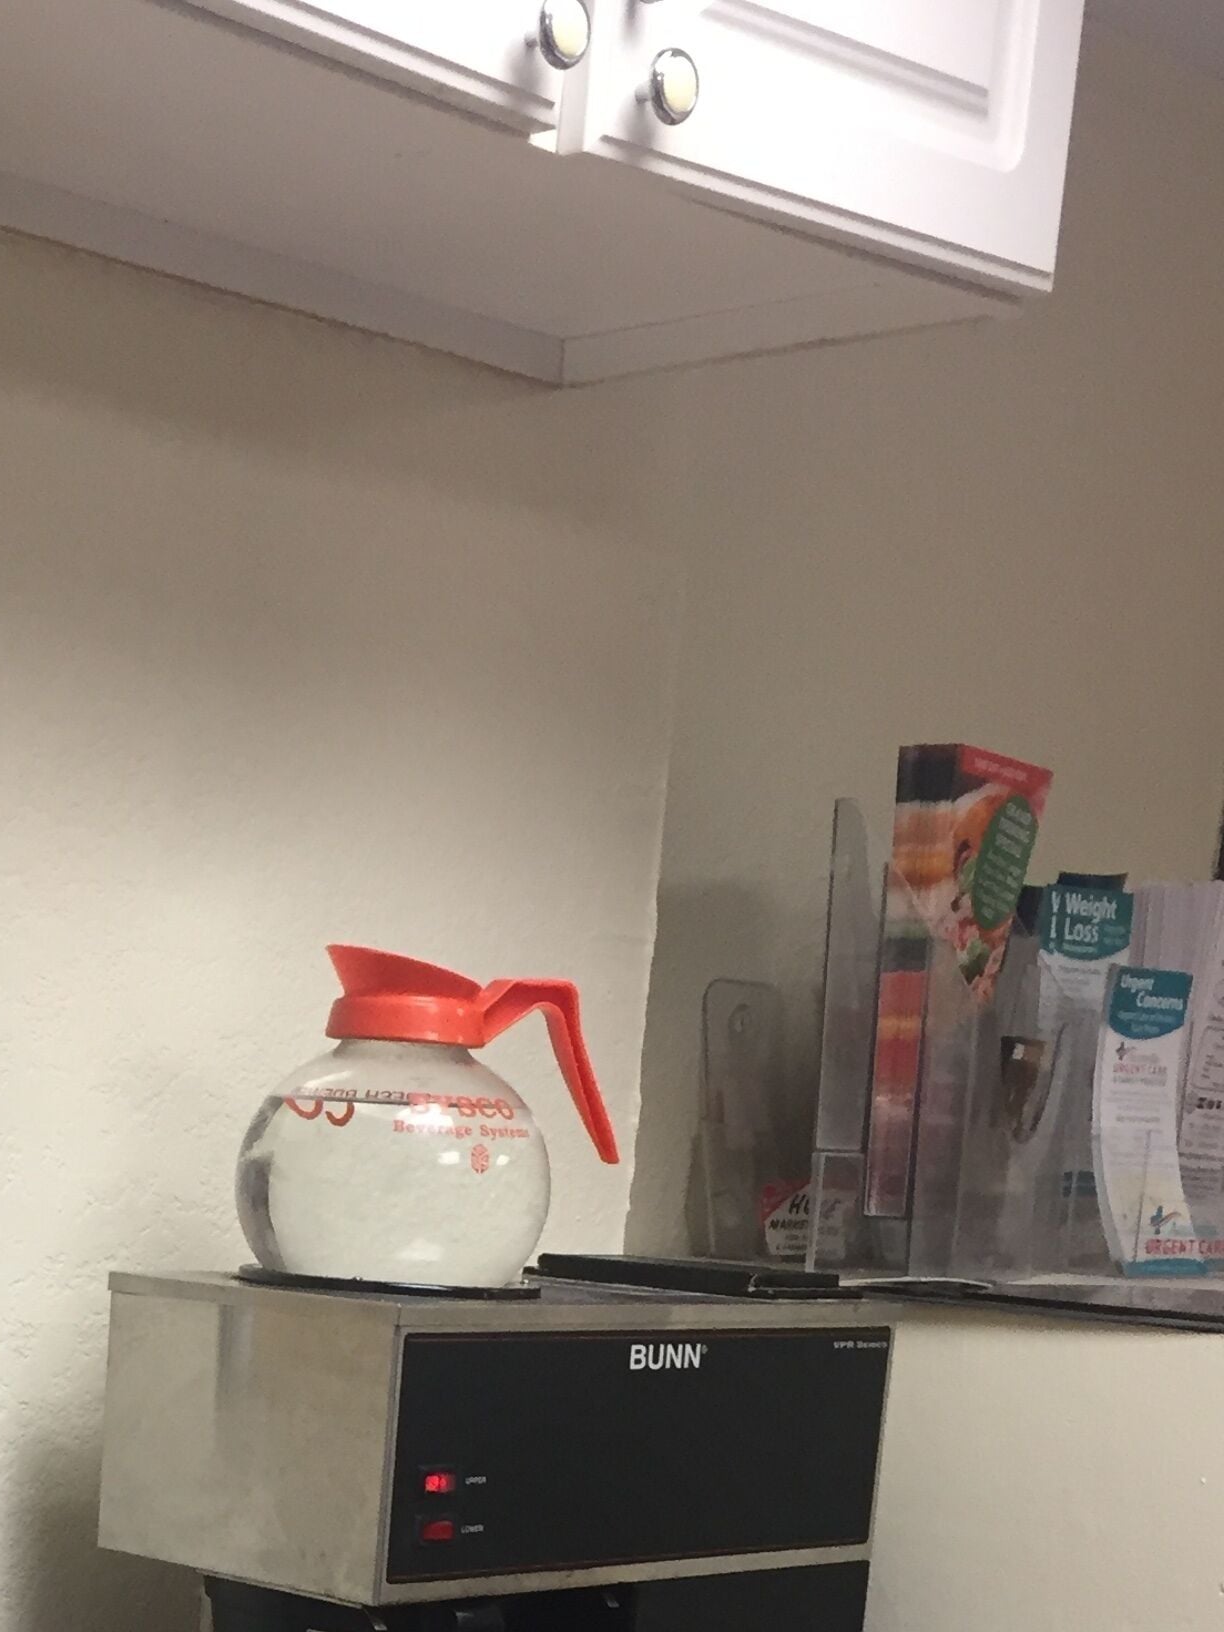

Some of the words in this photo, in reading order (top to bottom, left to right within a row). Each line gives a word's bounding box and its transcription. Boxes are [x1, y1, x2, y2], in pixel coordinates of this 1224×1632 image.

[1064, 892, 1117, 922] Weight
[1064, 917, 1099, 942] Loss
[393, 1119, 473, 1140] Beverage
[629, 1343, 702, 1371] BUNN
